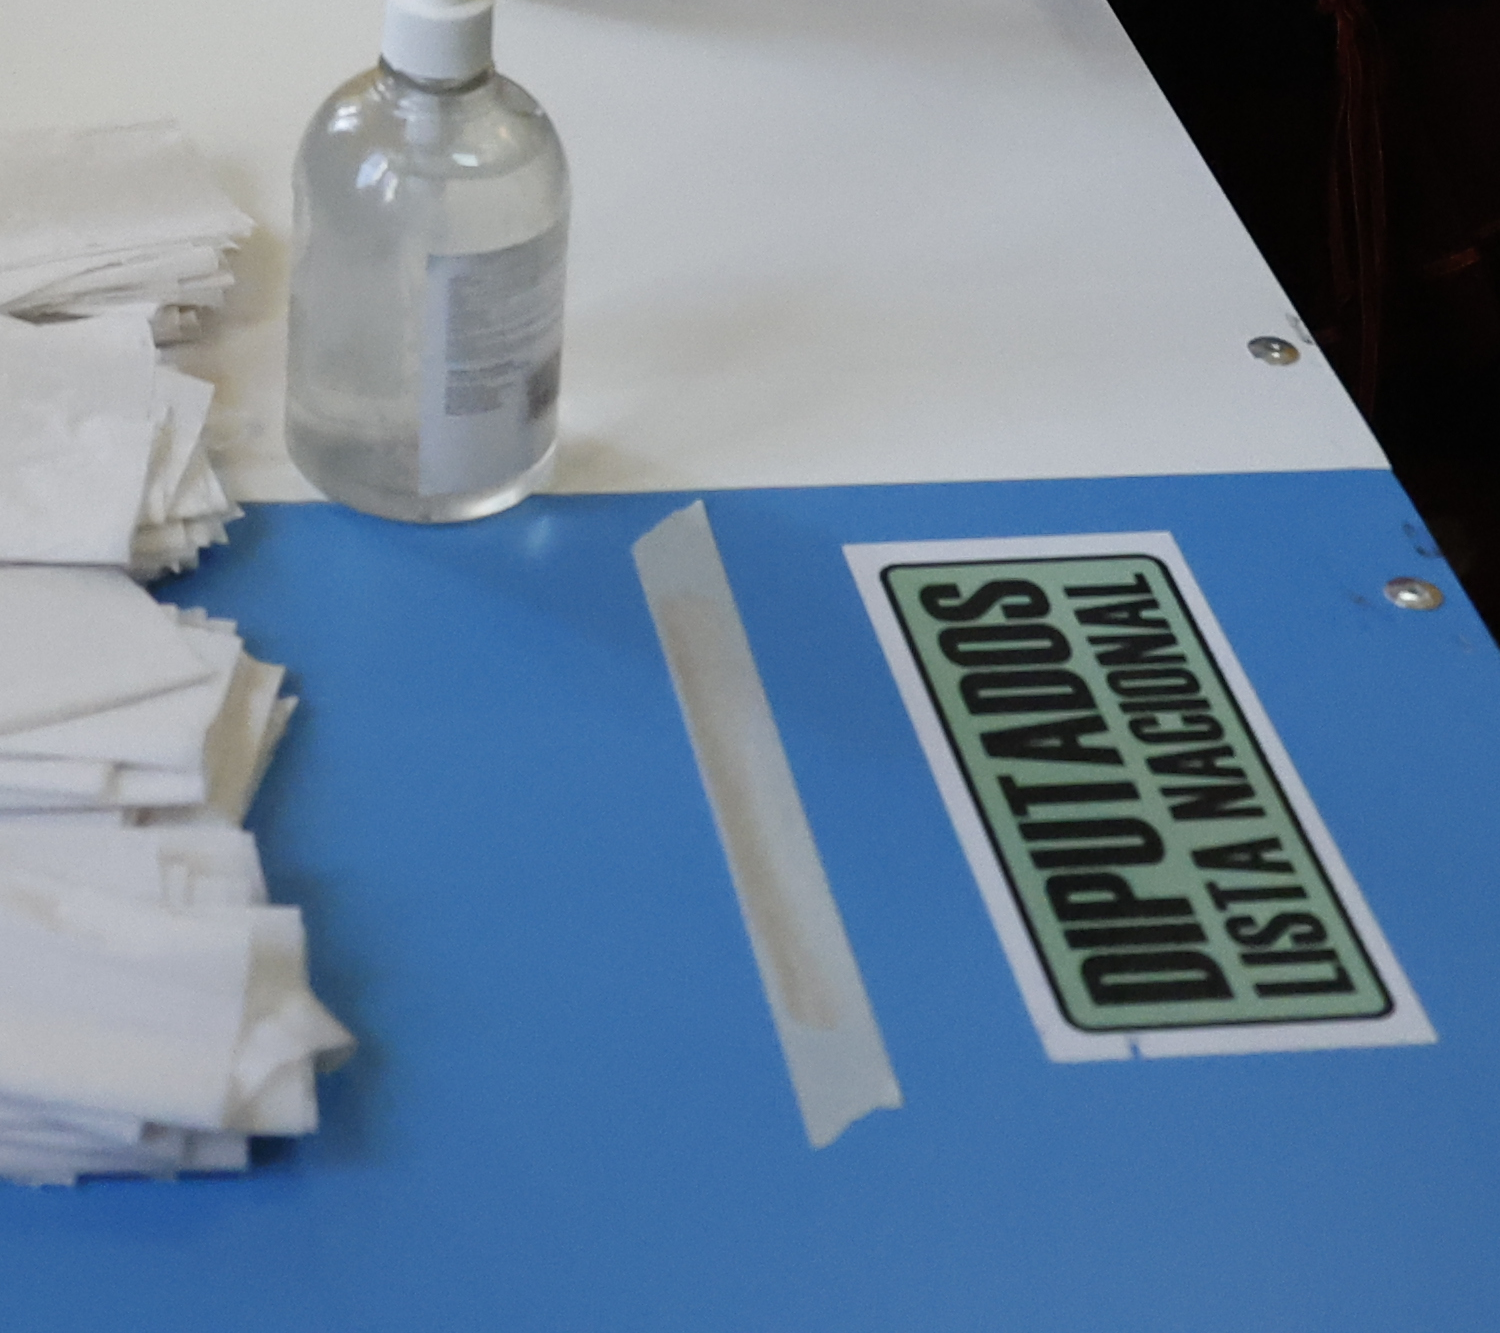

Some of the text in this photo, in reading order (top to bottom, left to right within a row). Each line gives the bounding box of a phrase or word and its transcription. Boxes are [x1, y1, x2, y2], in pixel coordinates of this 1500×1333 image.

[919, 577, 1236, 1007] DIPUTADOS
[1062, 572, 1357, 999] LISTA NACIONAL
